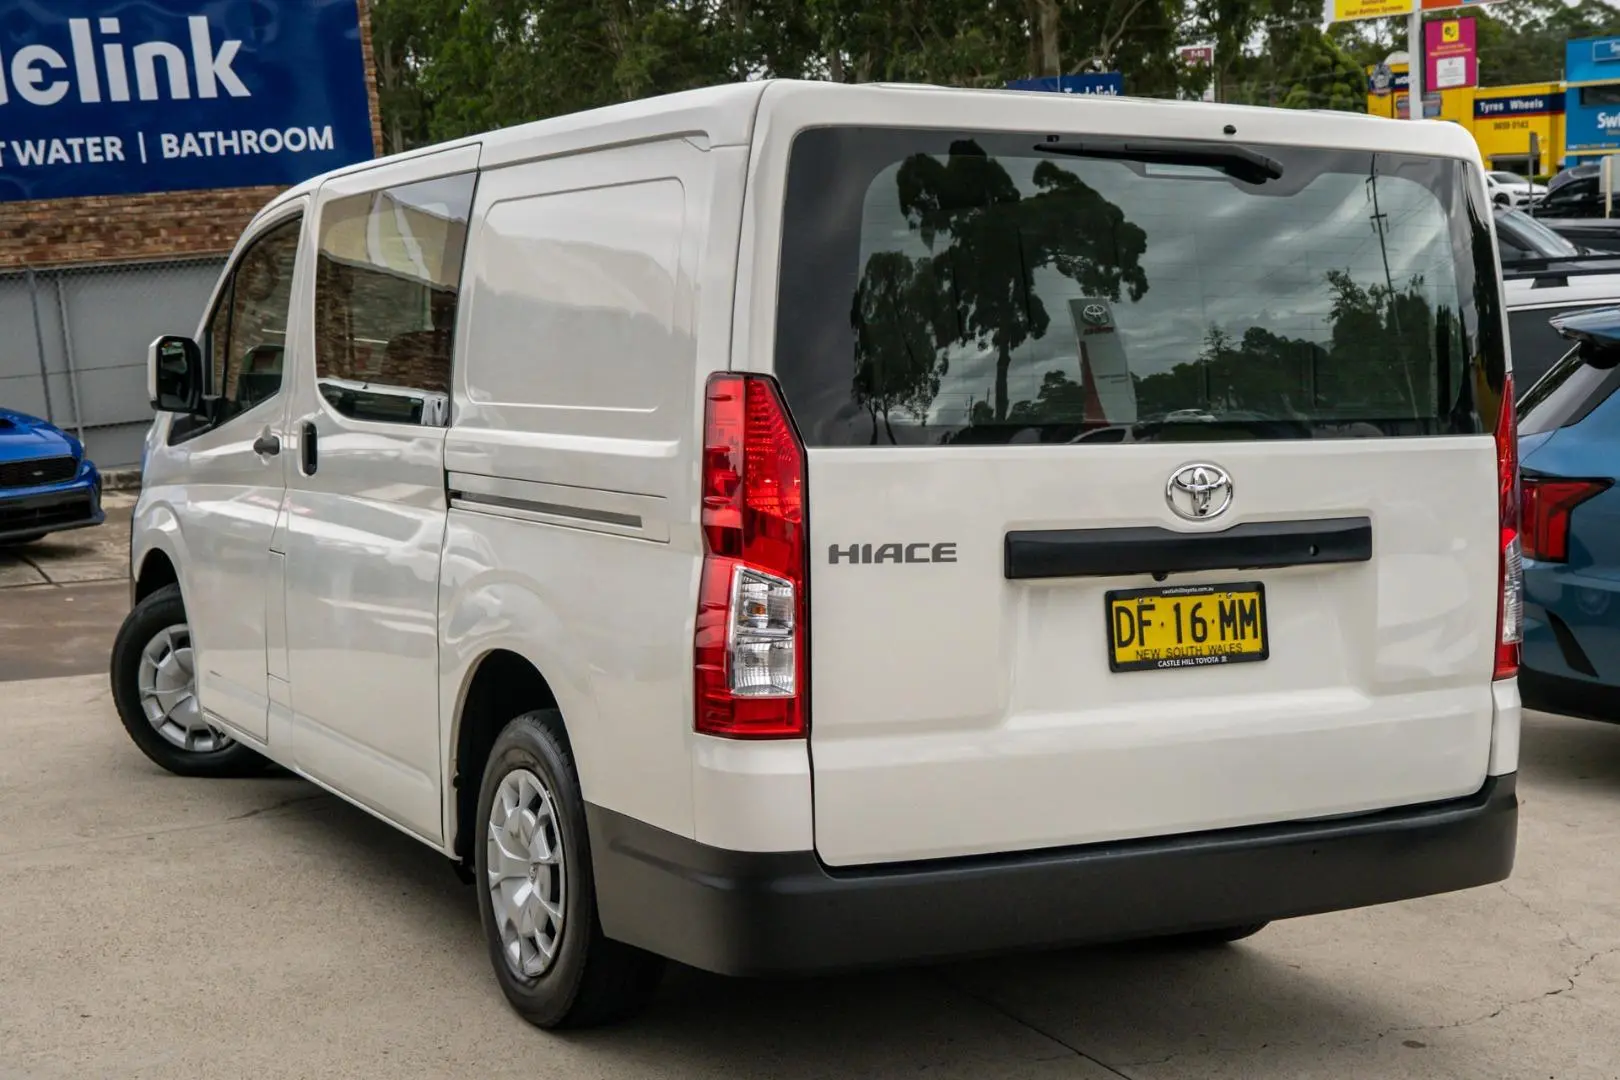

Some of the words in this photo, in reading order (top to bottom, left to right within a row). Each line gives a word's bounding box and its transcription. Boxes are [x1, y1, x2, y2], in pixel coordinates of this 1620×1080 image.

[0, 16, 252, 106] elink
[1480, 102, 1504, 114] Tyres
[1509, 98, 1545, 111] Wheels
[11, 136, 125, 167] WATER
[160, 125, 335, 159] BATHROOM
[828, 542, 958, 565] HIACE
[1115, 604, 1156, 649] DF
[1172, 601, 1208, 644] 16
[1218, 598, 1259, 641] MM
[1135, 648, 1161, 660] NEW
[1166, 645, 1203, 659] SOUTH
[1208, 642, 1243, 656] WALES
[1157, 660, 1181, 668] CASTLE
[1181, 658, 1195, 666] HILL
[1195, 656, 1220, 665] TOYOTA
